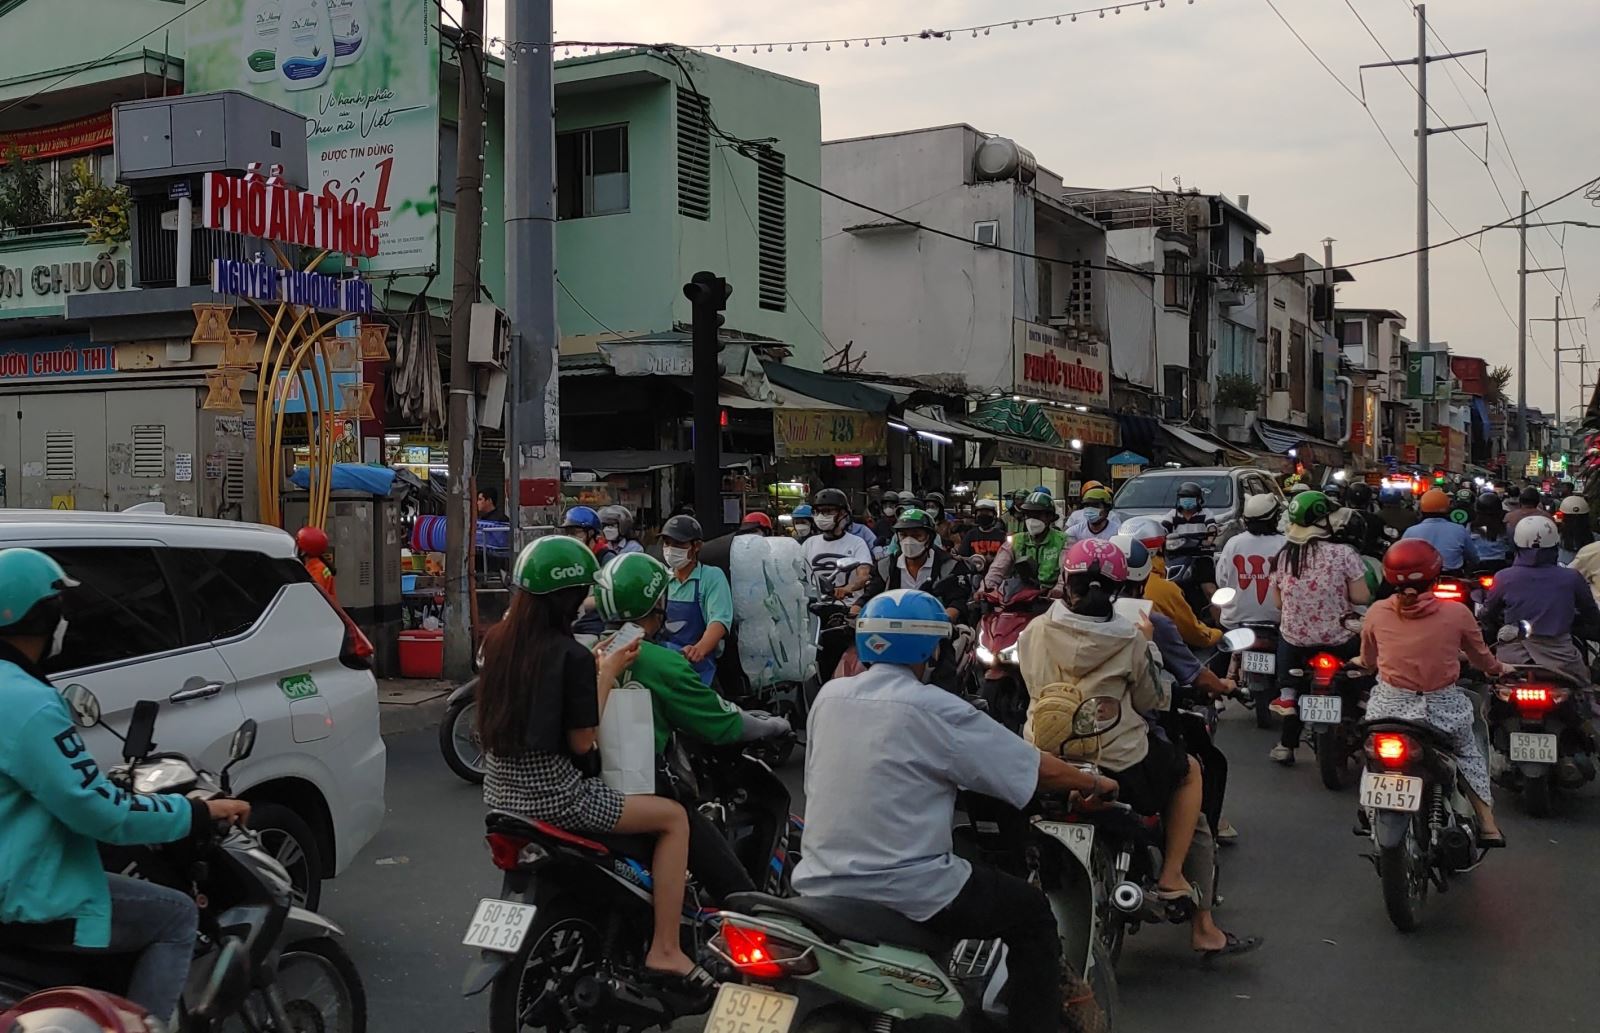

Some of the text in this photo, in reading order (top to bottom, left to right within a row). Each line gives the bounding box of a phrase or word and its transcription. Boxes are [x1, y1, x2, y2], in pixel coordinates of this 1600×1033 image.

[321, 143, 394, 162] ĐƯỢC TIN DÙNG
[203, 162, 380, 267] PHỐ ẨM THỰC
[31, 246, 126, 296] CHUỐI
[32, 343, 79, 375] CHUỐI
[81, 346, 107, 371] THI
[550, 564, 585, 580] Grab
[643, 571, 662, 598] Grab
[283, 676, 316, 696] Grab
[1307, 697, 1334, 709] 92-H1
[1303, 708, 1339, 721] 787.07
[1373, 776, 1411, 792] 74-B1
[1366, 790, 1416, 808] 161.57
[466, 923, 522, 948] 701.36
[726, 991, 783, 1024] 59-L2
